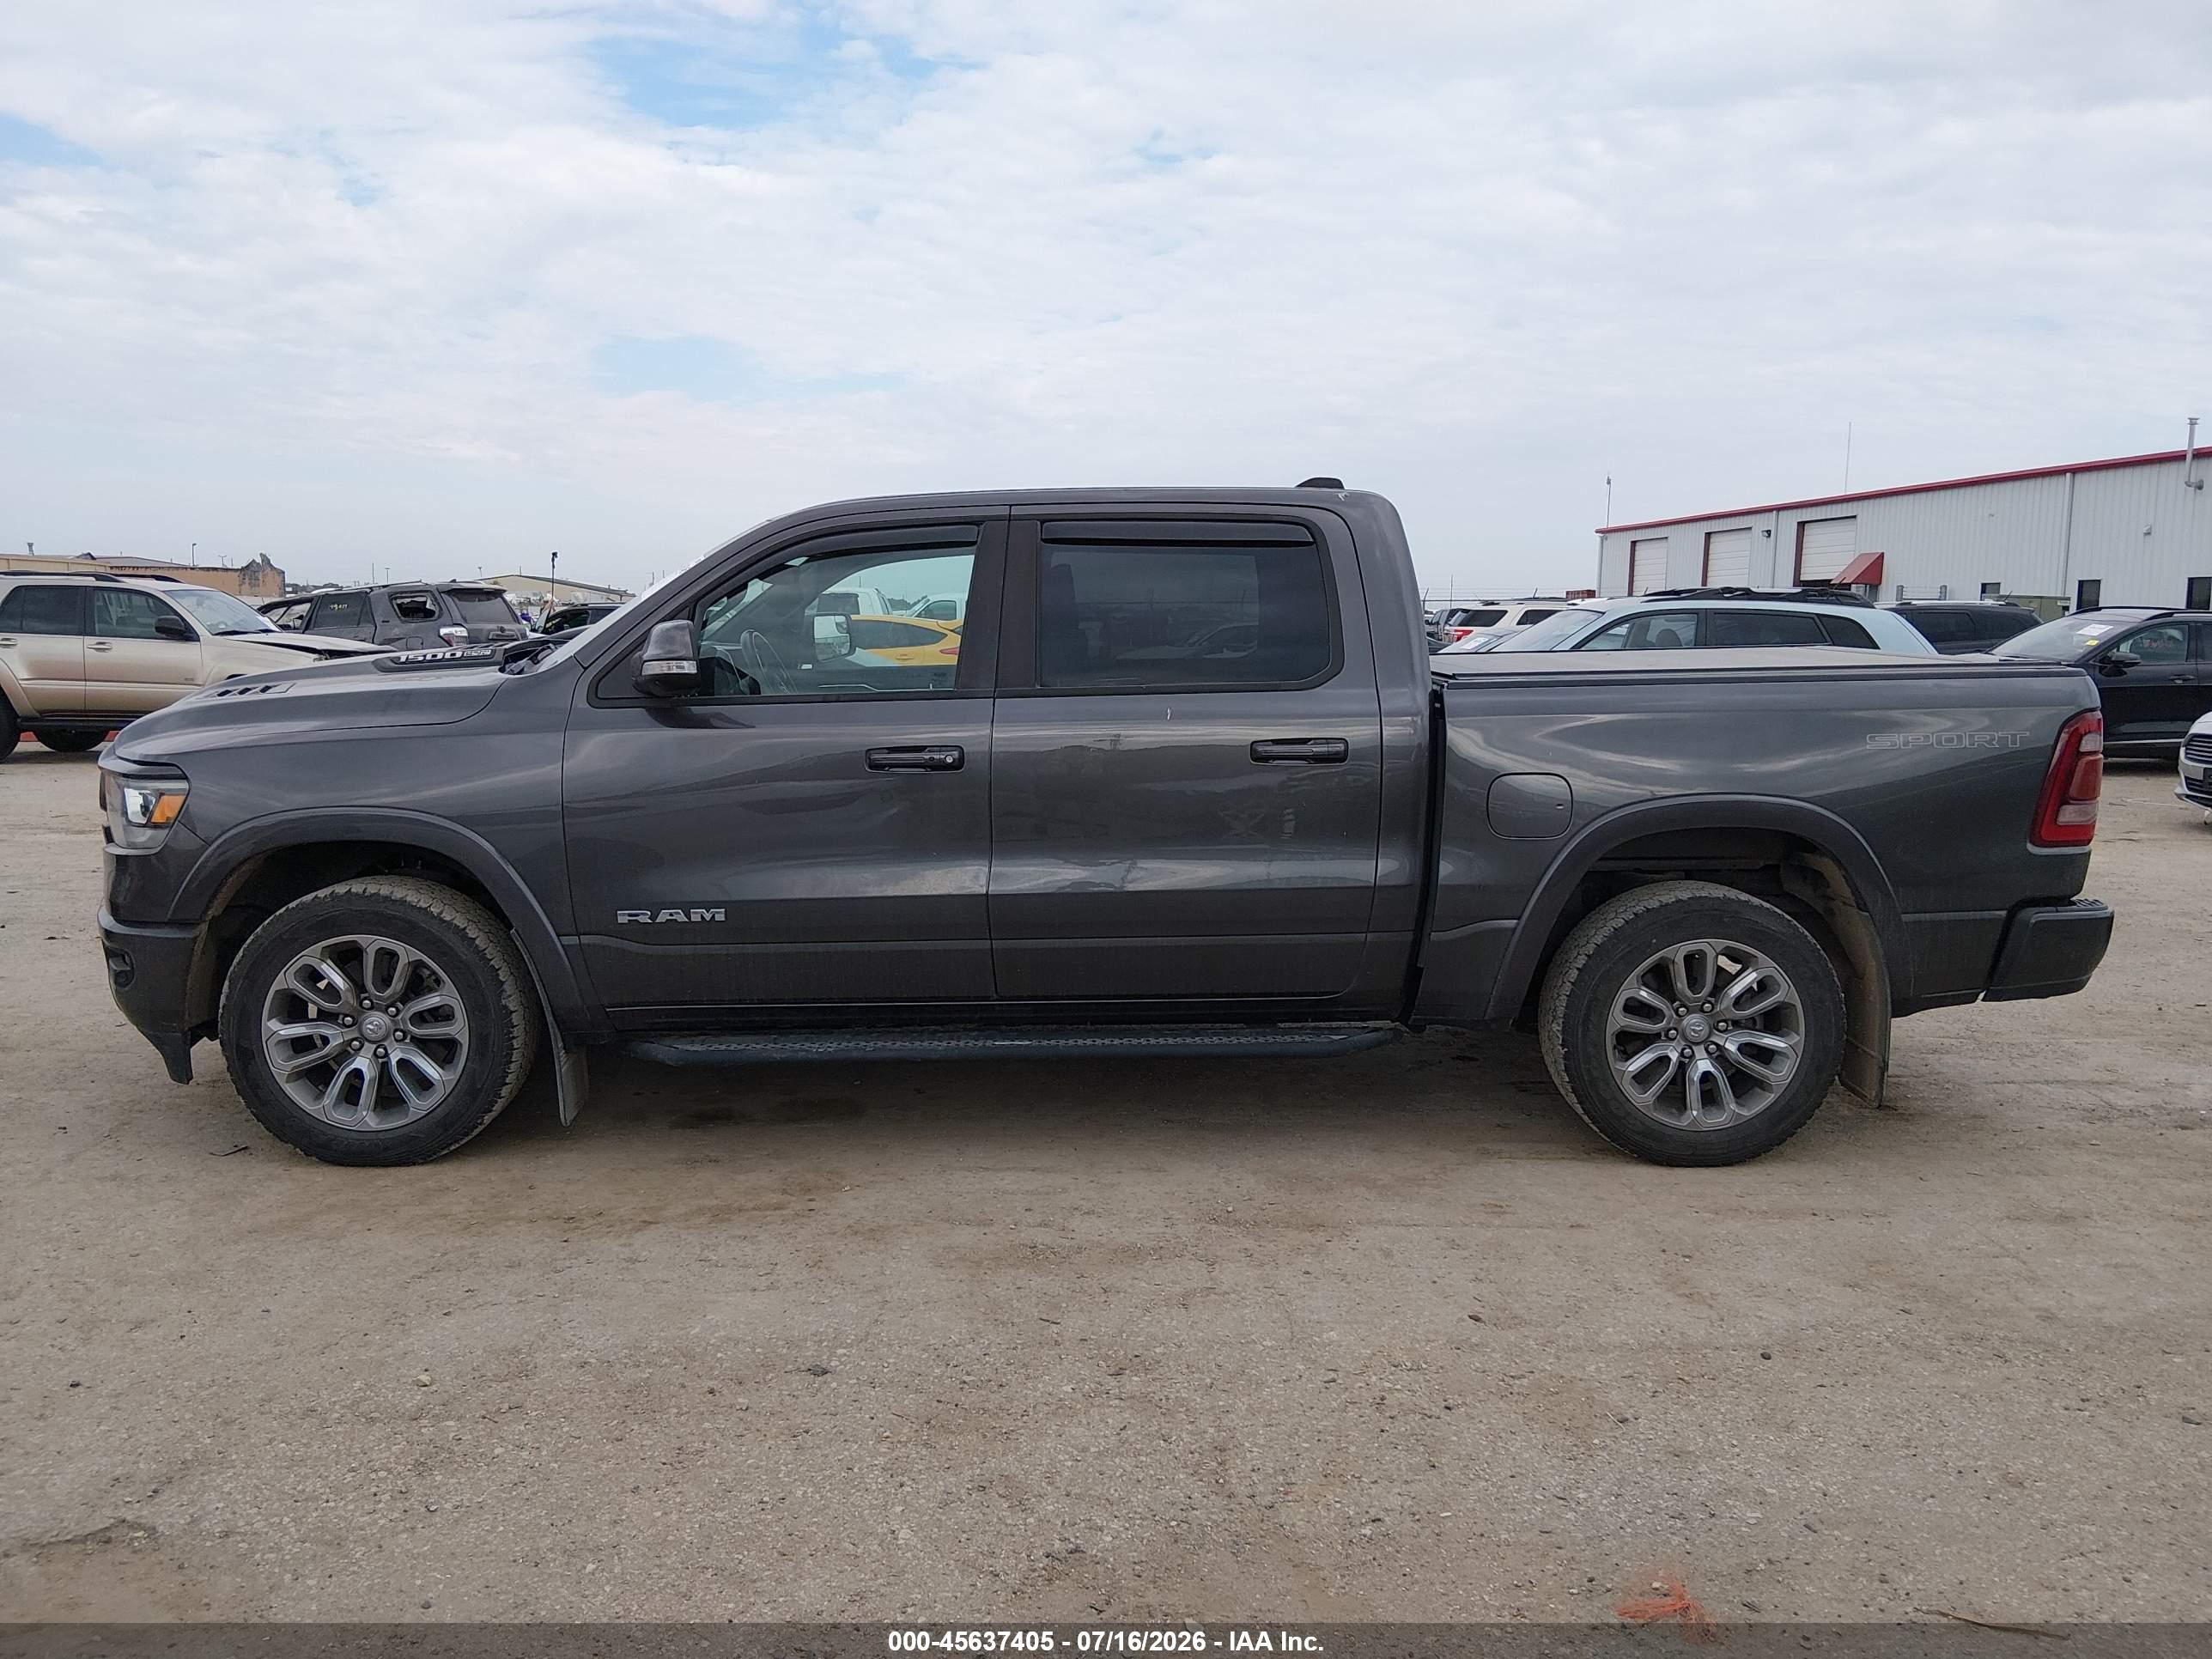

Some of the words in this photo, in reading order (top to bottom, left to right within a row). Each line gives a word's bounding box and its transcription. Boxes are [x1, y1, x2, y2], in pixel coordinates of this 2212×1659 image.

[399, 651, 463, 663] 1500
[1866, 731, 2030, 750] SPORT
[617, 908, 726, 924] RAM
